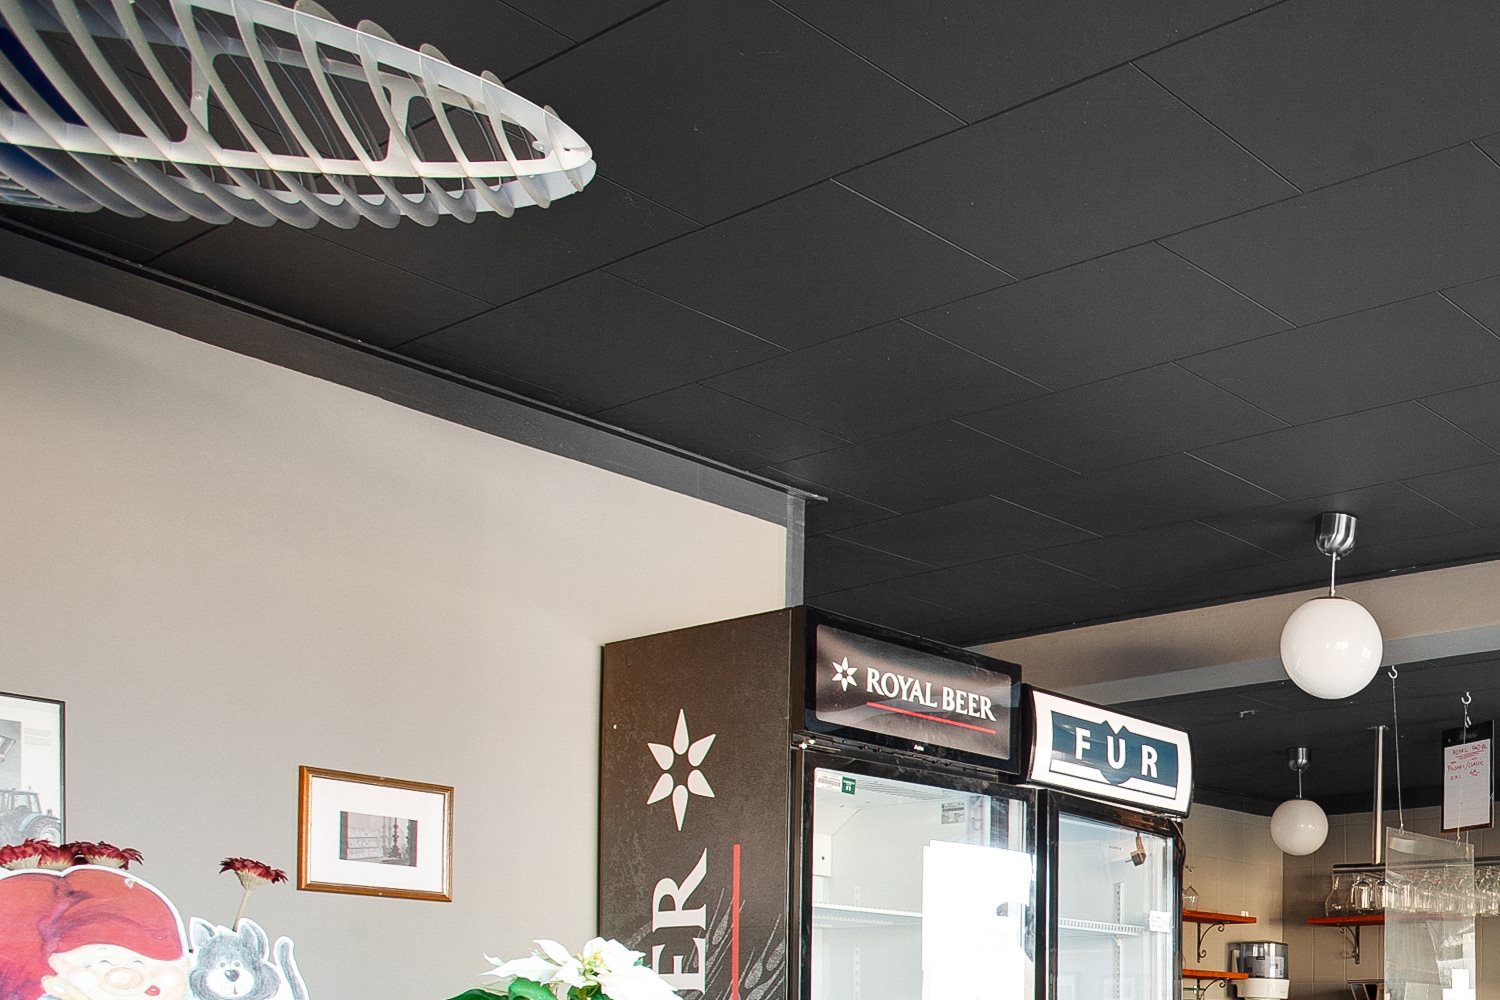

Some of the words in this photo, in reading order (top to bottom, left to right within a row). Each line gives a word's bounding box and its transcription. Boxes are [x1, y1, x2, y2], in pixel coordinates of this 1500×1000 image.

[866, 667, 938, 708] ROYAL
[942, 686, 997, 722] BEER
[1075, 726, 1158, 779] FUR
